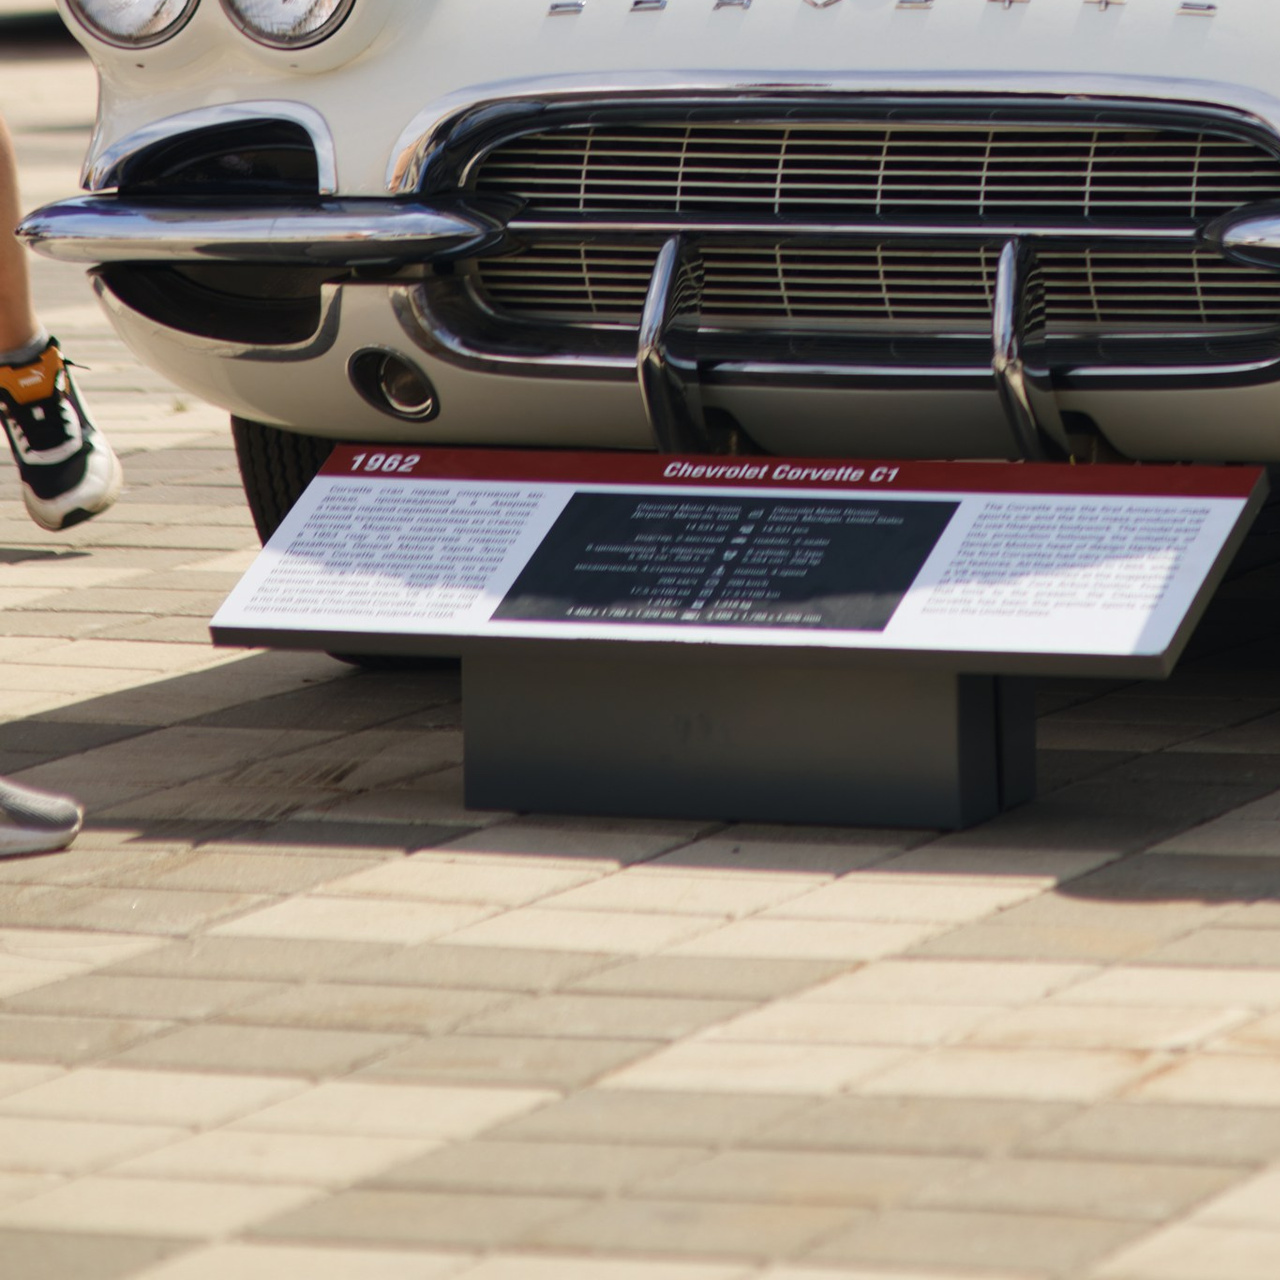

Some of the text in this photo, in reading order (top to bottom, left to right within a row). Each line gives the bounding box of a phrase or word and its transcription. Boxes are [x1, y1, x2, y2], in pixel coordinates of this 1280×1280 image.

[351, 452, 421, 473] 1962
[663, 461, 900, 483] Chevrolet Corvette C1
